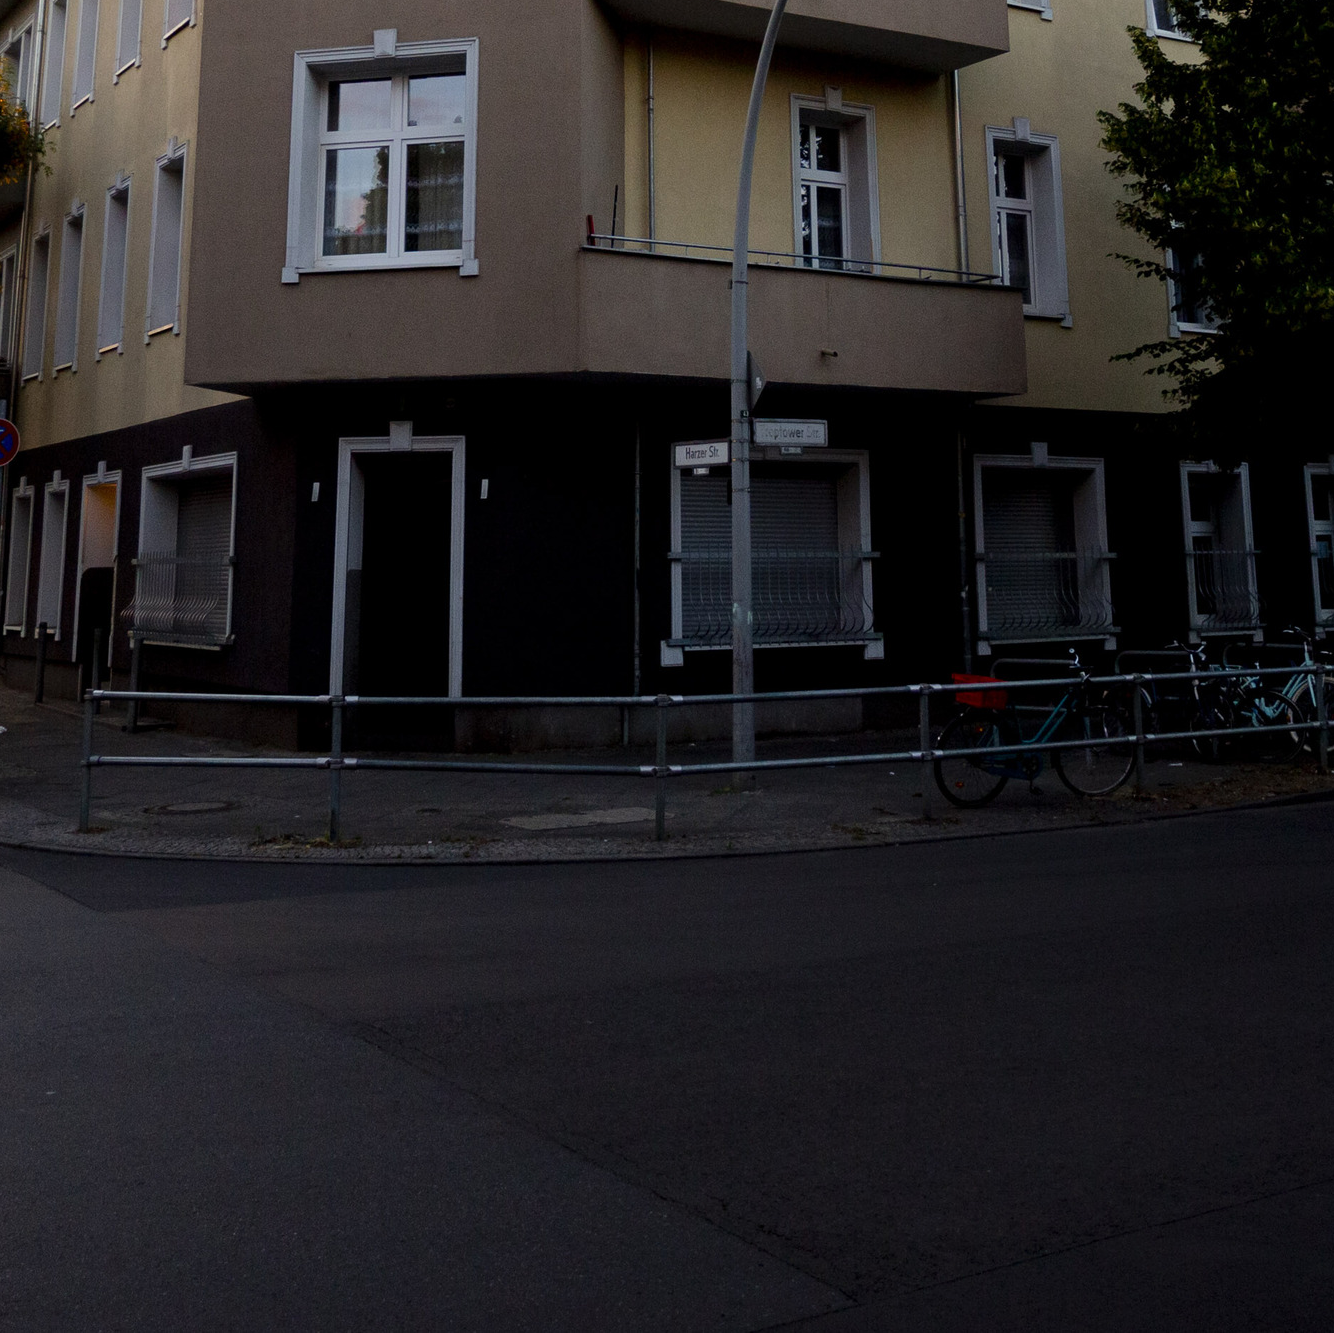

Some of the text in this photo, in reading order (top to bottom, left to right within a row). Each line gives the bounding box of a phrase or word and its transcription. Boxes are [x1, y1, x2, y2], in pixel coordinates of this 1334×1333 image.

[758, 424, 804, 441] eptower
[685, 445, 720, 460] Harzer Str.
